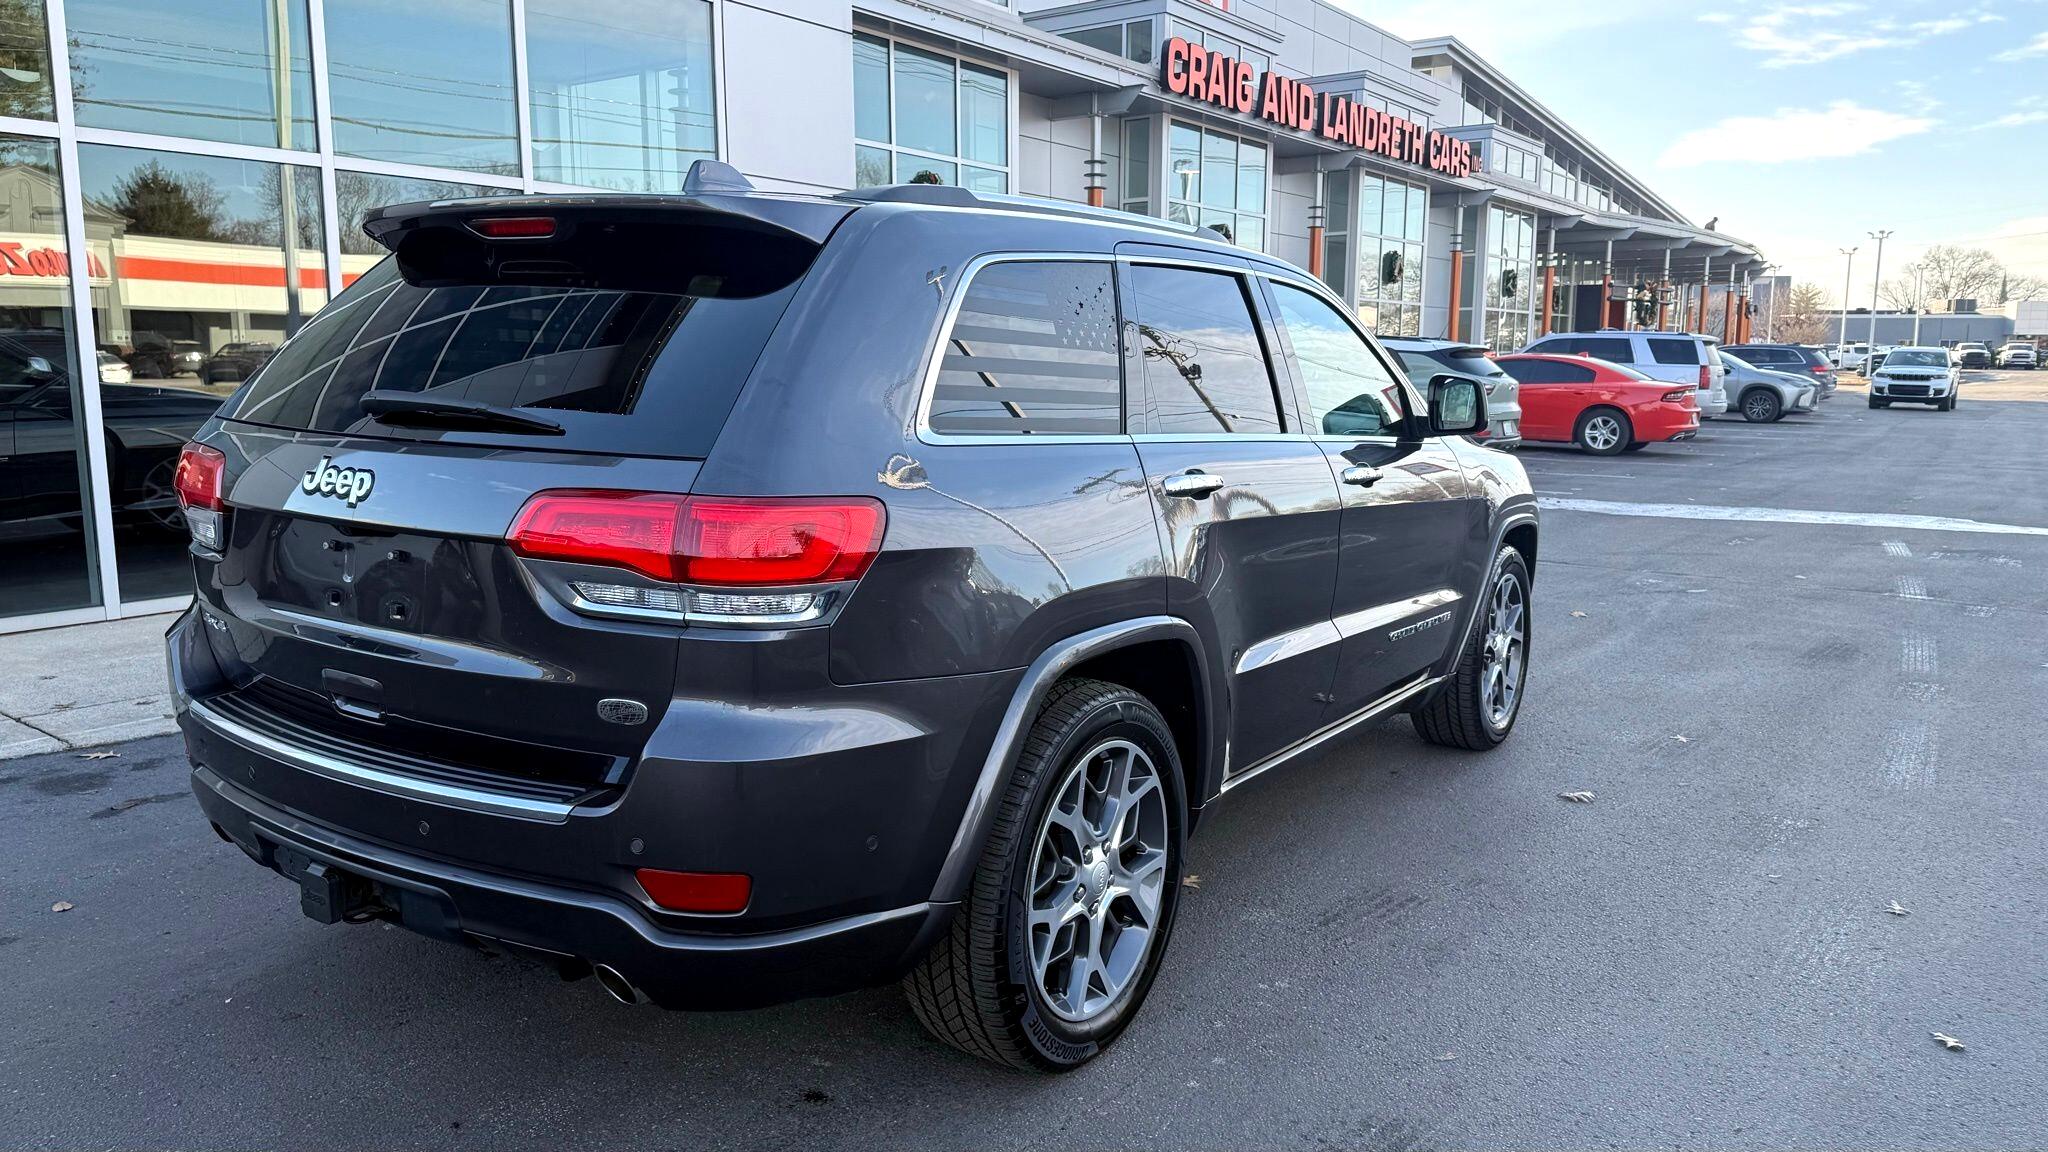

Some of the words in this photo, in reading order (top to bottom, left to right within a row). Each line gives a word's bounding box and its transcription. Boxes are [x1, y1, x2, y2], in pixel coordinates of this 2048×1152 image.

[1166, 36, 1255, 113] CRAIG
[1261, 71, 1315, 132] AND
[1322, 91, 1425, 165] LANDRETH
[1429, 129, 1471, 178] CARS
[302, 455, 375, 508] Jeep
